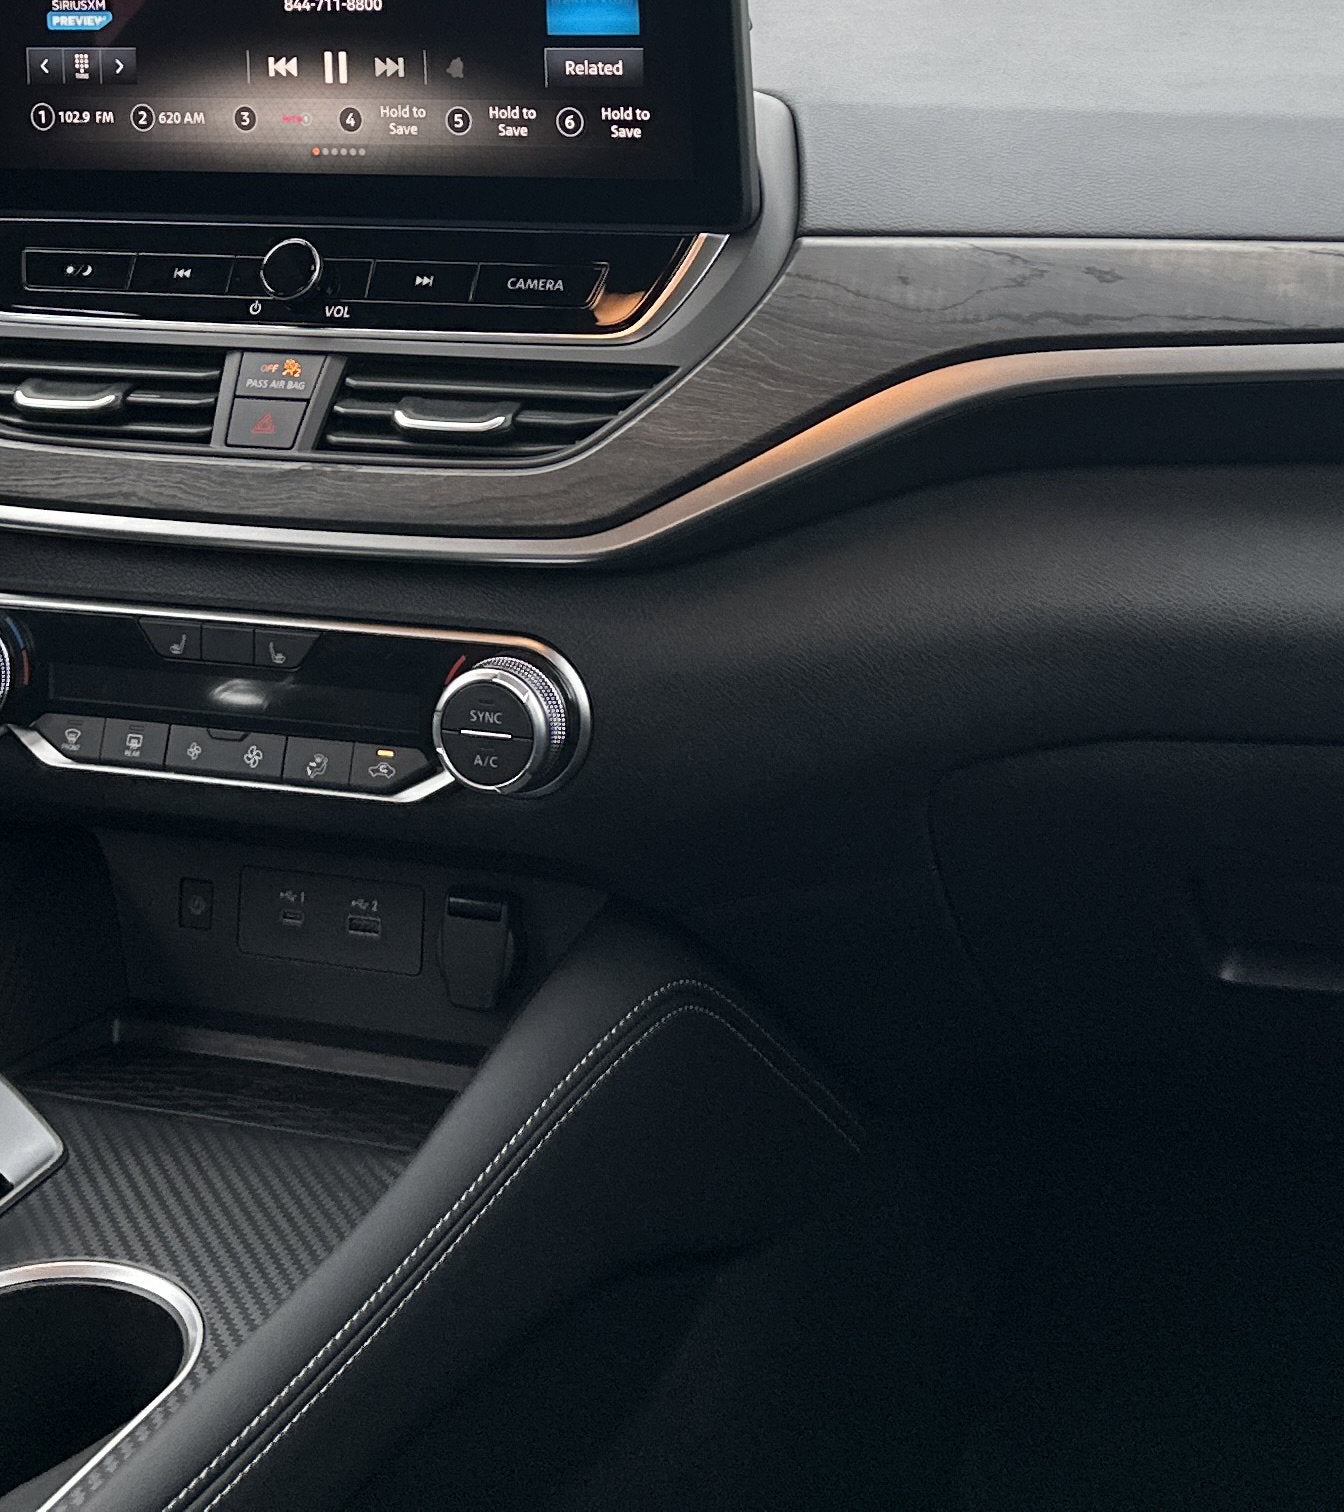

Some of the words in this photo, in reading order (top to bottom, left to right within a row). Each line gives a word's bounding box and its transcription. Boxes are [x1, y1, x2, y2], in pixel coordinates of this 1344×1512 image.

[51, 0, 106, 12] SIRIUSXM
[52, 14, 105, 27] PREVIEW
[565, 59, 623, 76] Related
[58, 110, 91, 124] 102.9
[95, 111, 115, 124] FM
[159, 111, 182, 124] 620
[183, 111, 205, 124] AM
[380, 104, 408, 119] Hold
[409, 107, 426, 119] to
[488, 105, 517, 120] Hold
[519, 108, 536, 120] to
[601, 106, 631, 122] Hold
[633, 109, 650, 121] to
[389, 123, 418, 136] Save
[498, 123, 528, 137] Save
[610, 124, 642, 138] Save
[507, 275, 564, 292] CAMERA
[324, 304, 351, 319] VOL
[260, 363, 279, 372] OFF
[246, 378, 268, 388] PASS
[269, 380, 286, 388] AIR
[286, 381, 305, 390] BAG
[469, 709, 503, 725] SYNC
[473, 754, 499, 768] A/C
